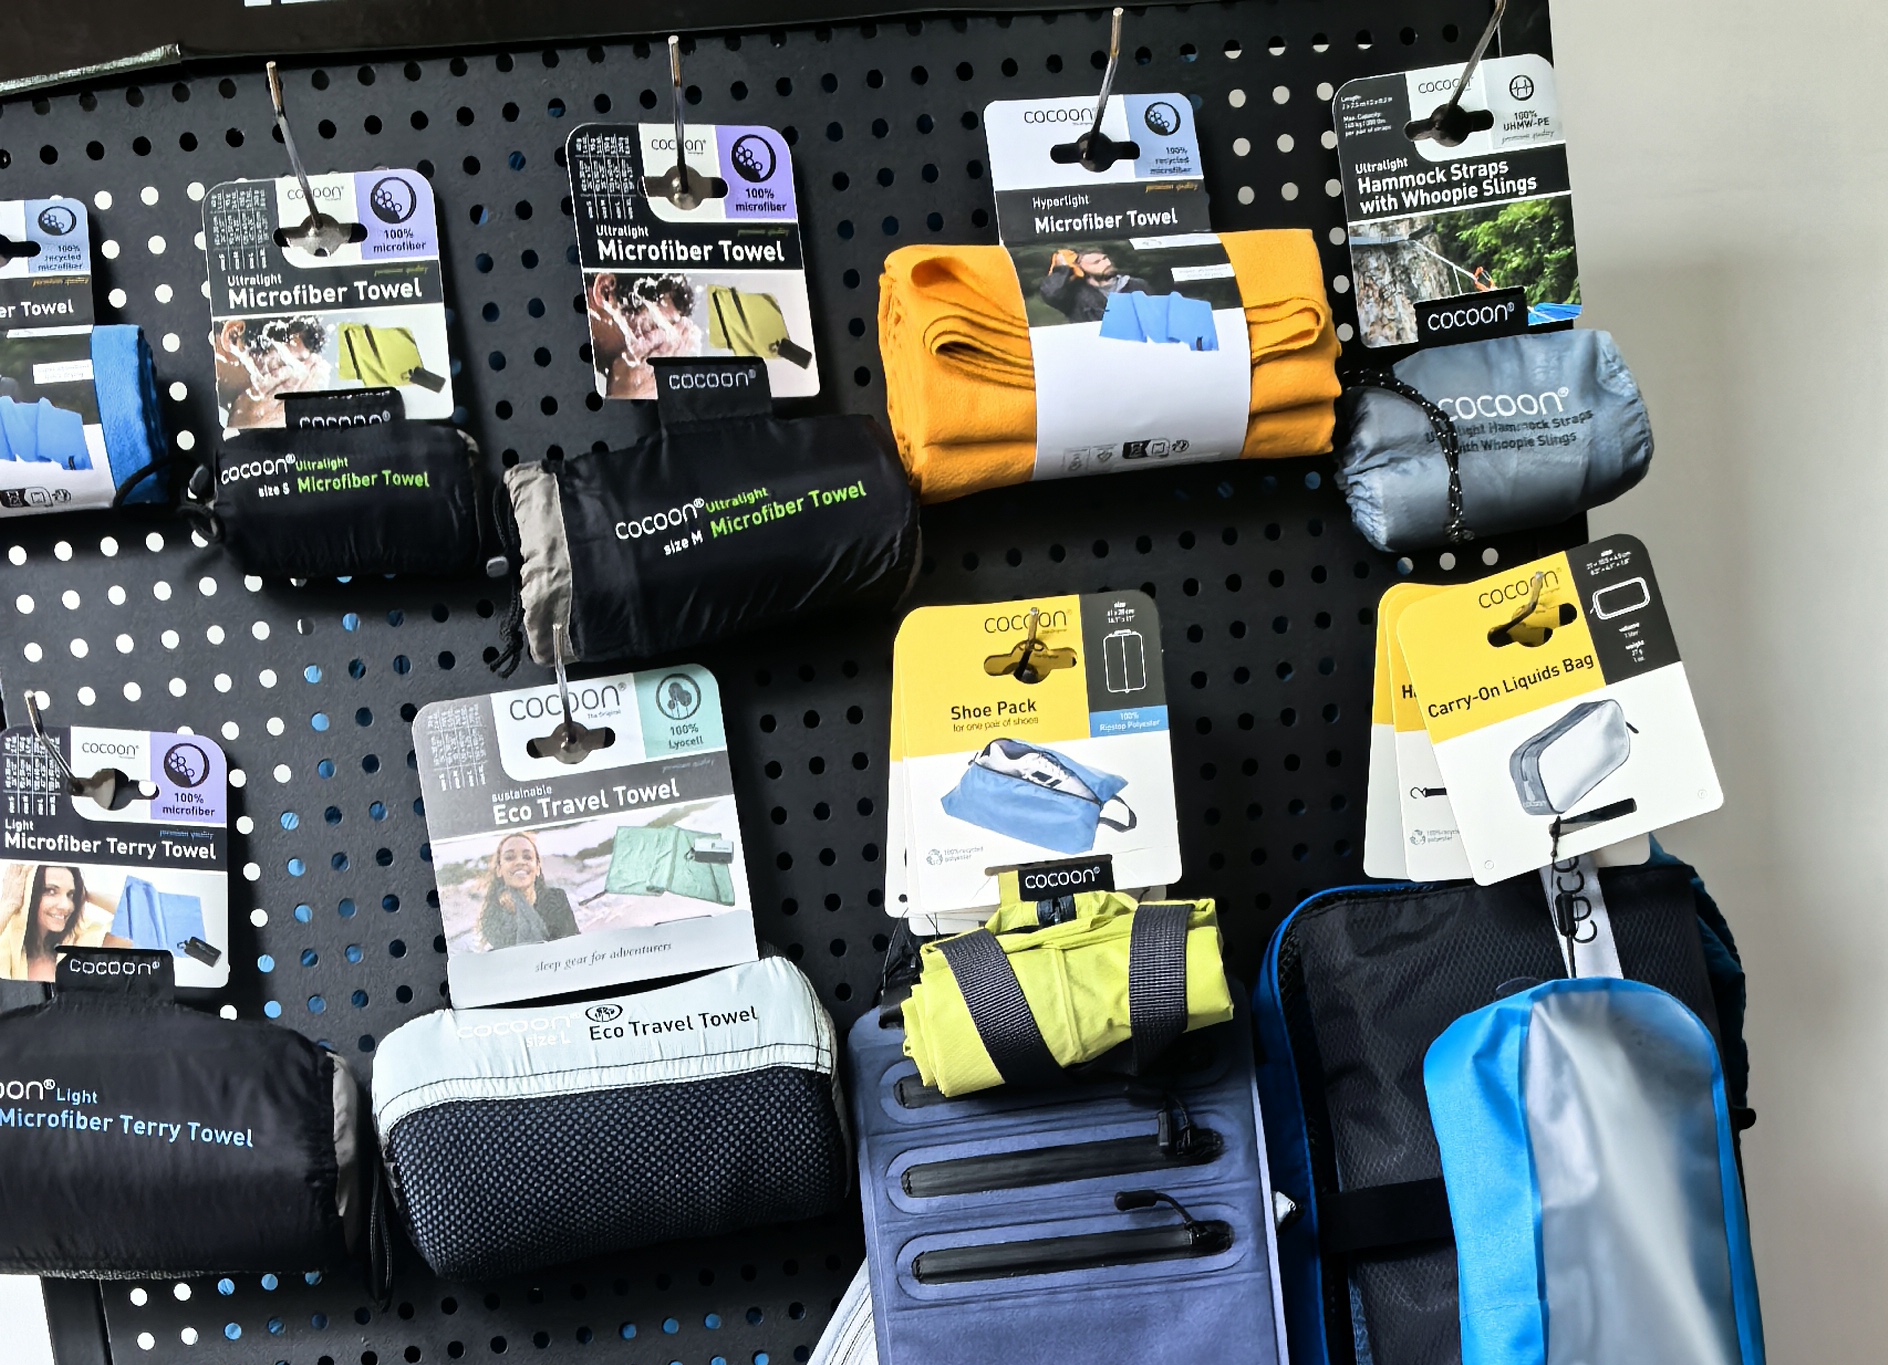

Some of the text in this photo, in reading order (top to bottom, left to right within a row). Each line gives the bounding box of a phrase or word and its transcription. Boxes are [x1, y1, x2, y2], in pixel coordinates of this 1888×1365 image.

[1503, 117, 1550, 131] UHMW-PE
[1355, 157, 1409, 174] Ultralight
[1357, 160, 1509, 194] Hammock Straps
[745, 188, 775, 199] 100%
[1360, 174, 1538, 215] with Whoopie Slings
[736, 202, 787, 212] microfiber
[1035, 208, 1178, 234] Microfiber Towel
[596, 225, 648, 243] Ultralight
[373, 241, 426, 253] microfiber
[597, 240, 785, 261] Microfiber Towel
[228, 274, 282, 287] Ultralight
[228, 278, 422, 309] Microfiber Towel
[21, 299, 74, 318] Towel
[296, 457, 348, 472] Ultralight
[297, 470, 430, 493] Microfiber Towel
[259, 484, 290, 498] size S
[705, 487, 768, 513] Ultralight
[710, 480, 866, 539] Microfiber Towel
[664, 530, 704, 556] size M
[1428, 685, 1500, 718] Carry-On
[1502, 666, 1560, 695] Liquids
[1563, 655, 1594, 674] Bag
[951, 698, 1037, 720] Shoe Pack
[670, 724, 698, 736] 100%
[668, 736, 704, 749] Lyocell
[174, 793, 204, 803] 100%
[492, 785, 552, 803] sustainable
[493, 779, 680, 825] Eco Travel Towel
[163, 806, 215, 816] microfiber
[5, 819, 34, 831] Light
[4, 832, 216, 860] Microfiber Terry Towel
[589, 1006, 758, 1041] Eco Travel Towel
[57, 1088, 98, 1105] Light
[0, 1108, 253, 1147] Microfiber Terry Towel
